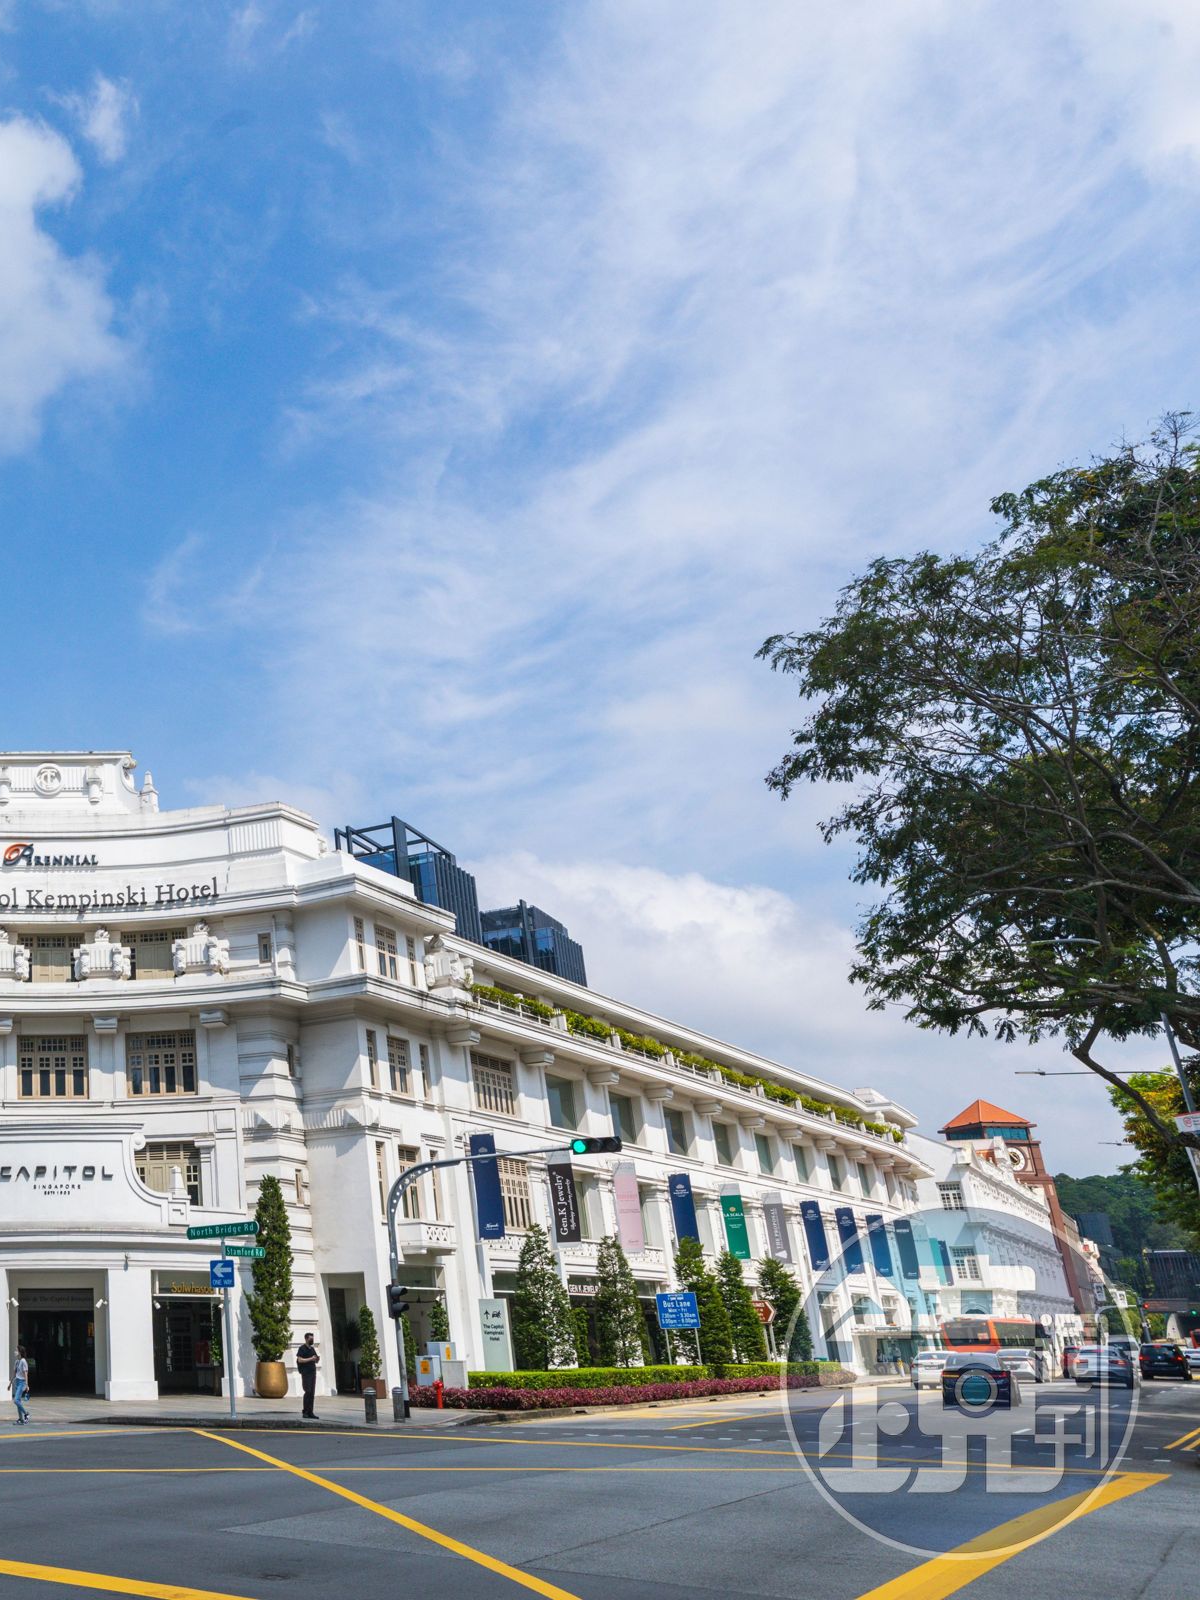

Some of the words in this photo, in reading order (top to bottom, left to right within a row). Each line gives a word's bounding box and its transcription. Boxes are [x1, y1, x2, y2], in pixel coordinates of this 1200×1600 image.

[2, 843, 98, 866] PERENNIAL
[27, 886, 147, 911] Kempinski
[155, 877, 220, 903] Hotel
[0, 1166, 113, 1181] CAPITOL
[190, 1227, 212, 1236] North
[216, 1226, 242, 1235] Bridge
[244, 1224, 254, 1232] Rd
[558, 1207, 568, 1236] Gen.K
[676, 1300, 690, 1308] Lane
